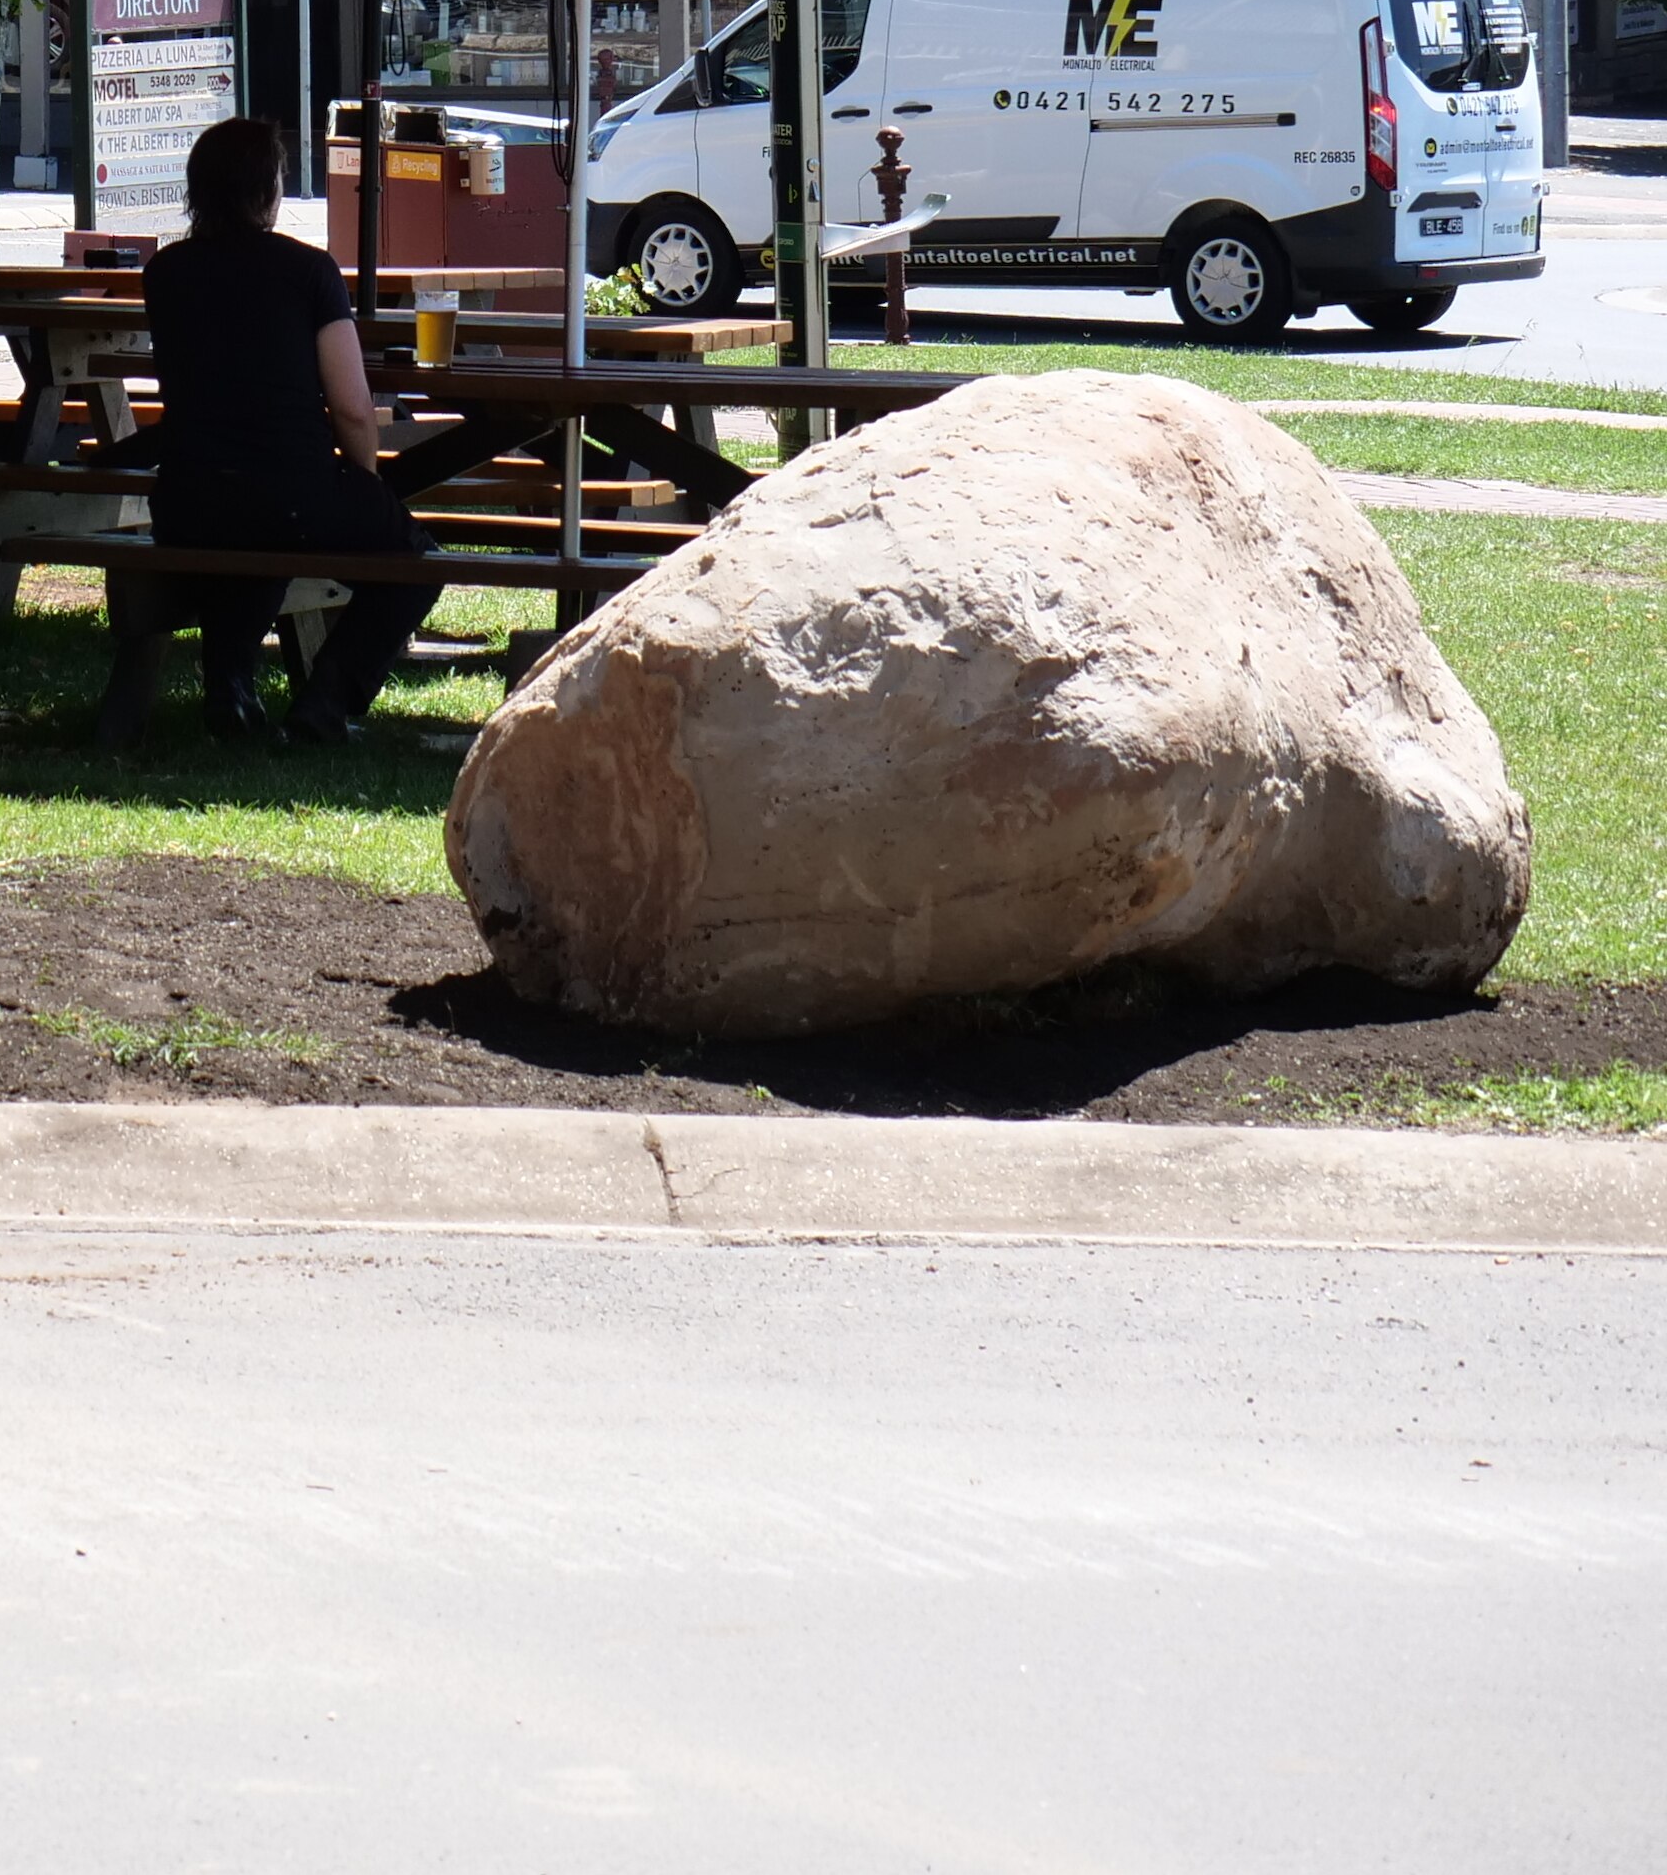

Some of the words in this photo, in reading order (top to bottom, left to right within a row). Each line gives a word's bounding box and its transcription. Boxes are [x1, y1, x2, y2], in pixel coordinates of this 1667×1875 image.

[92, 51, 144, 69] PIZZERIA
[147, 49, 164, 65] LA
[167, 45, 197, 64] LUNA
[1062, 59, 1102, 70] MONTALTO
[1110, 59, 1156, 71] ELECTRICAL
[94, 78, 139, 103] MOTEL
[150, 76, 171, 88] 5348
[174, 74, 196, 87] 2029
[1017, 91, 1086, 111] 0421
[1108, 92, 1162, 112] 542
[1181, 94, 1235, 114] 275
[106, 108, 142, 126] ALBERT
[145, 106, 163, 123] DAY
[166, 105, 183, 122] SPA
[107, 136, 127, 154] THE
[130, 134, 169, 152] ALBERT
[173, 131, 193, 149] B&B
[402, 158, 438, 175] Recycling
[1294, 151, 1317, 163] REC
[1320, 151, 1356, 163] 26835
[110, 165, 137, 178] MASSAGE
[138, 165, 144, 176] &
[145, 163, 171, 175] NATURAL
[142, 185, 183, 206] BISTRO
